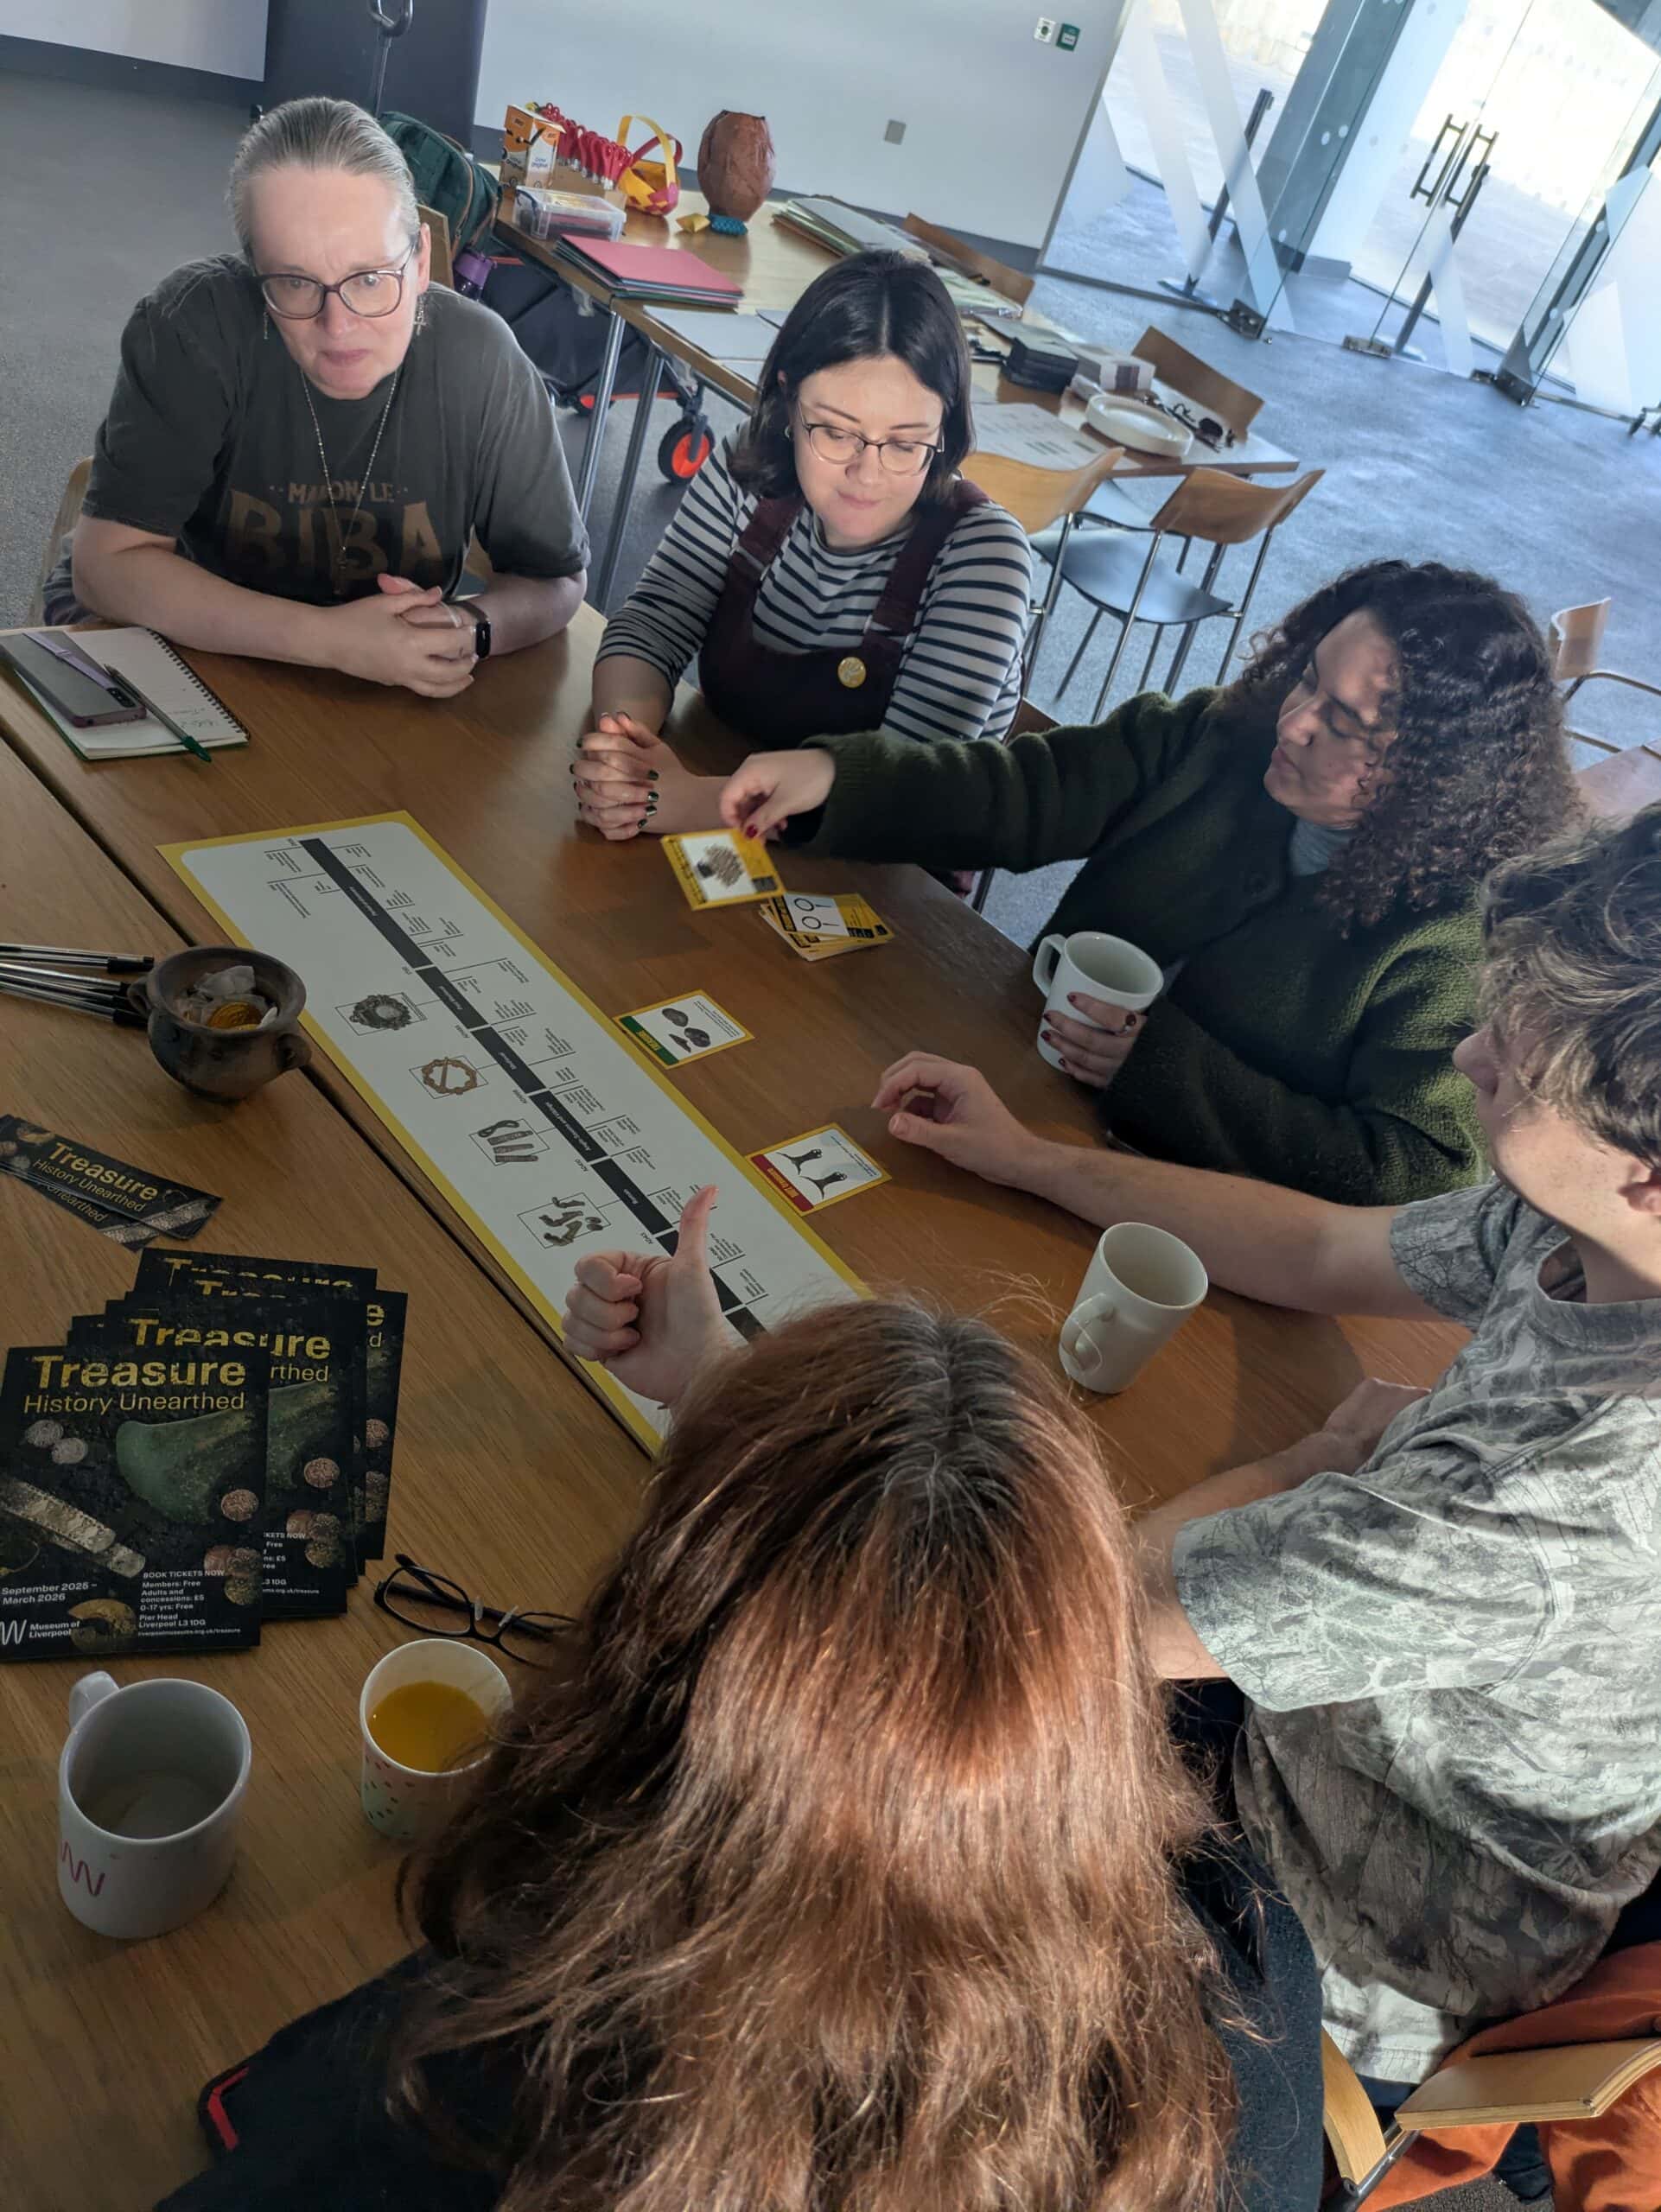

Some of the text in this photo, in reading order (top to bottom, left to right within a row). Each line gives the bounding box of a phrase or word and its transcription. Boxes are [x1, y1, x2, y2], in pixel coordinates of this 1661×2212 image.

[48, 1142, 159, 1201] Treasure
[33, 1159, 146, 1212] History Unearthed
[33, 1355, 247, 1389] Treasure
[270, 1364, 329, 1382] rthed
[23, 1392, 245, 1415] History Unearthed
[2, 1584, 60, 1596] September
[61, 1582, 89, 1591] 2025
[3, 1593, 67, 1605] March 2026
[29, 1629, 72, 1638] Liverpool
[30, 1621, 69, 1630] Museum
